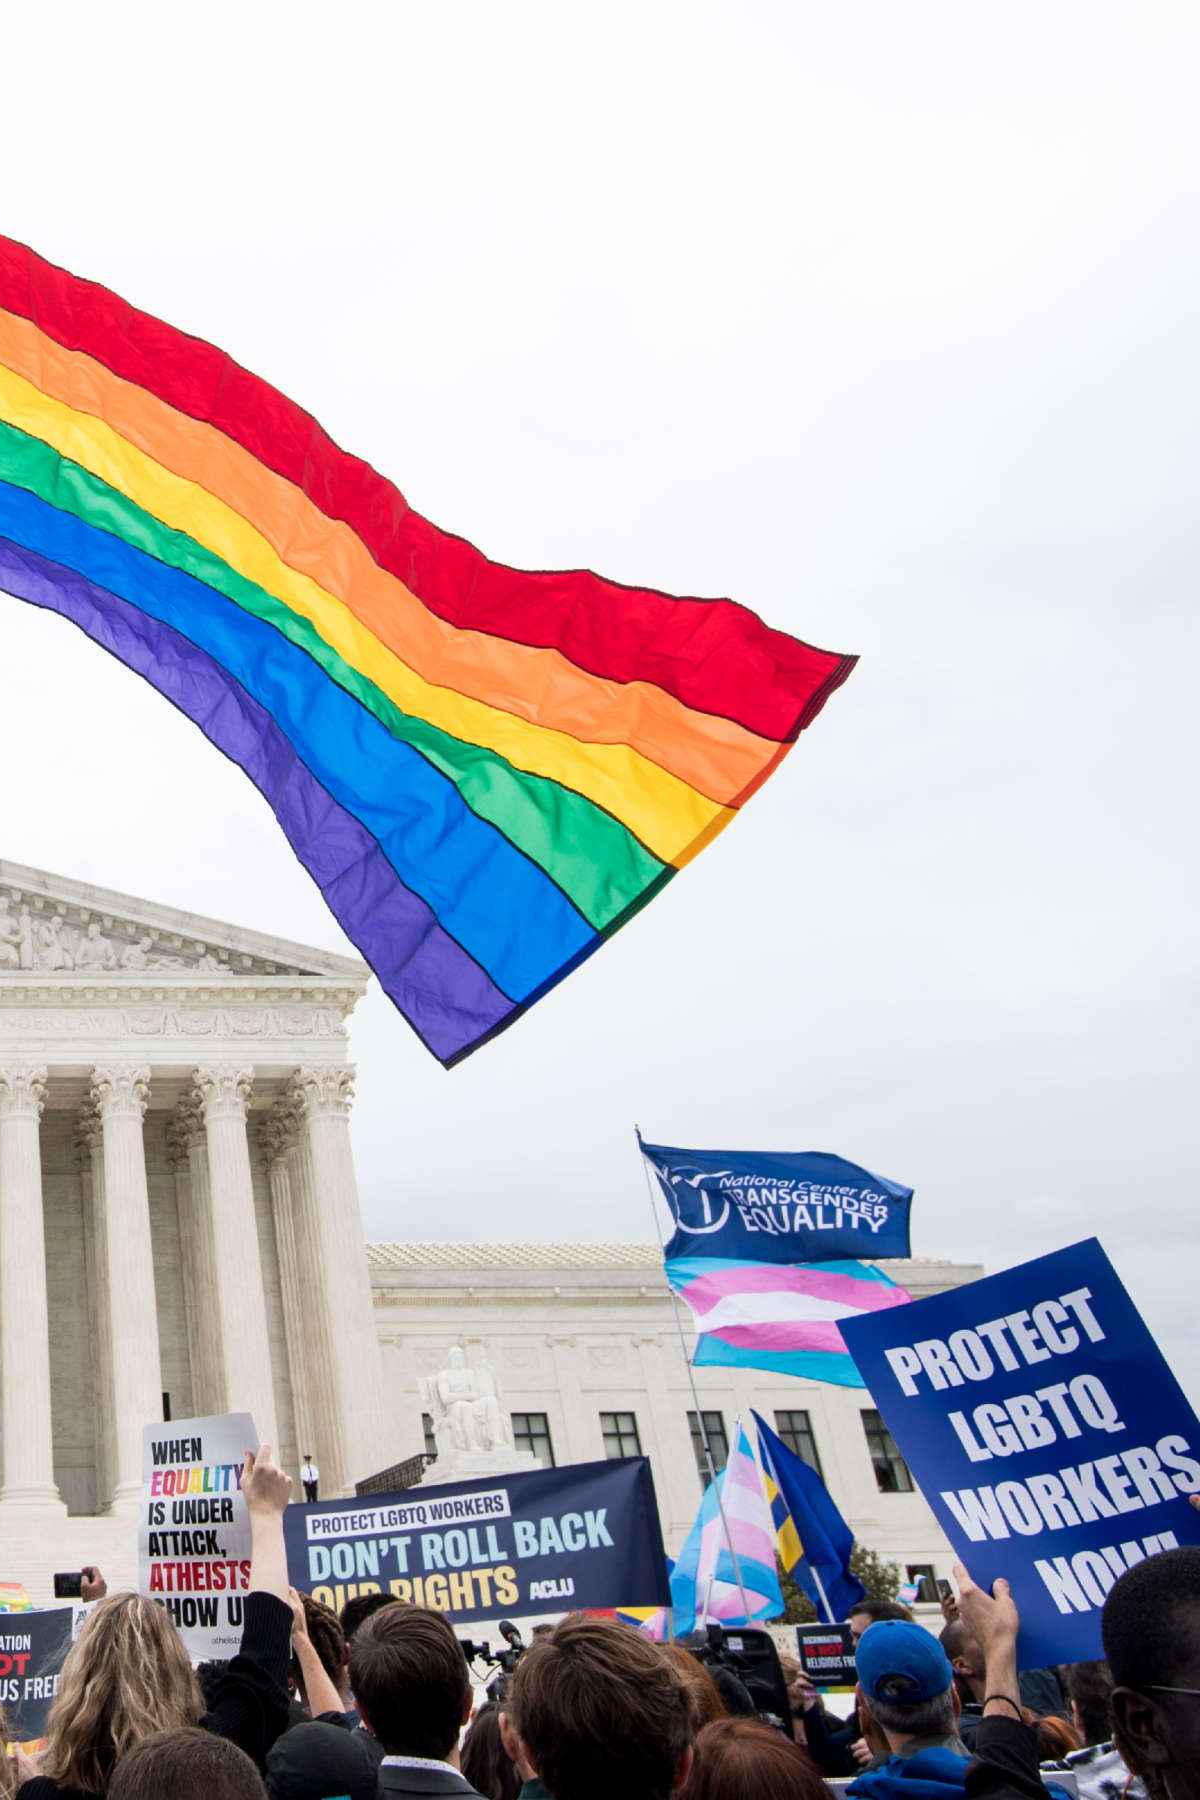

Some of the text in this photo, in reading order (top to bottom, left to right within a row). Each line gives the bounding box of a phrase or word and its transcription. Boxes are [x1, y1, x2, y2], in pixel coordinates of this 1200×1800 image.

[719, 1174, 888, 1204] National Center for
[722, 1188, 889, 1219] TRANSGENDER
[737, 1205, 888, 1235] EQUALITY
[883, 1287, 1106, 1397] PROTECT
[947, 1374, 1126, 1463] LGBTQ
[151, 1437, 203, 1465] WHEN
[150, 1463, 246, 1497] EQUALITY
[940, 1434, 1200, 1542] WORKERS
[148, 1498, 234, 1526] IS UNDER
[311, 1494, 505, 1534] PROTECT LGBTQ WORKERS
[149, 1529, 227, 1558] ATTACK,
[307, 1508, 615, 1582] DON'T ROLL BACK
[150, 1559, 252, 1592] ATHEISTS
[1033, 1530, 1180, 1615] NO
[529, 1577, 575, 1601] ACLU
[152, 1597, 219, 1628] HOW
